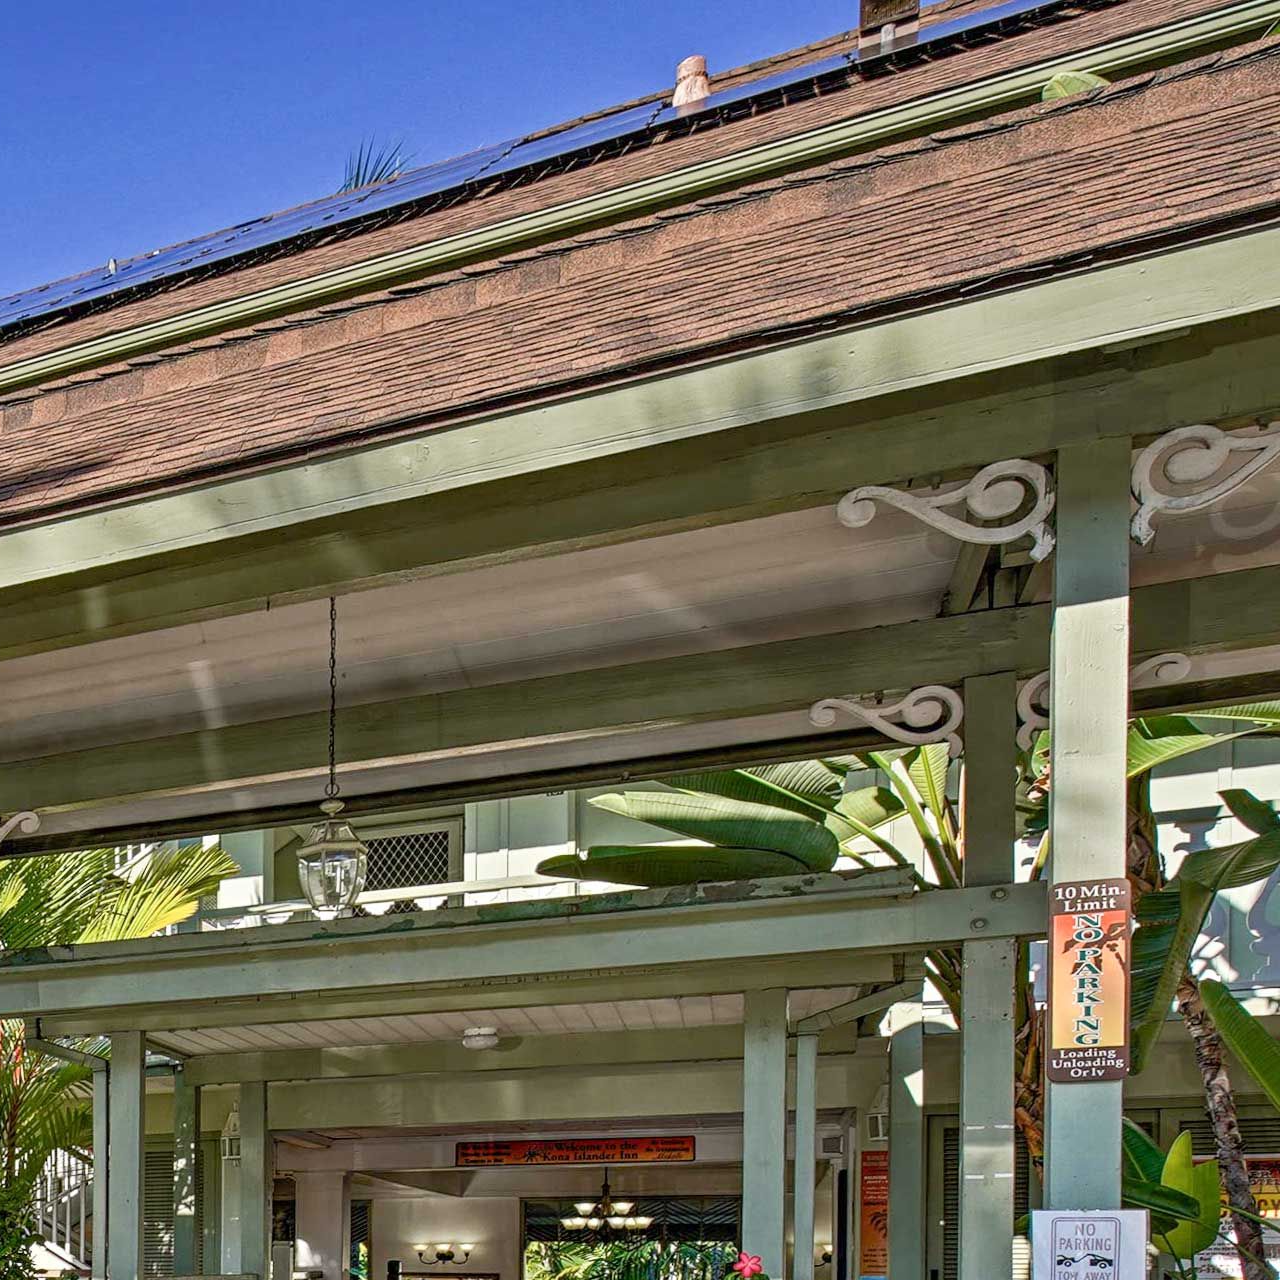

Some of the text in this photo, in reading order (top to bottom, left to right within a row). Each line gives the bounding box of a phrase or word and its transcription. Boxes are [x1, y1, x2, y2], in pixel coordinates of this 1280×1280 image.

[1054, 883, 1126, 900] 10 Min.
[1063, 897, 1117, 912] Limit
[1072, 912, 1104, 1046] NO PARKING
[1060, 1048, 1117, 1059] Loading
[1052, 1058, 1125, 1069] Unloading
[543, 1151, 639, 1161] Kona Islander Inn
[1074, 1223, 1096, 1236] NO
[1058, 1237, 1112, 1251] PARKING
[1057, 1271, 1112, 1280] TOW AWAY
